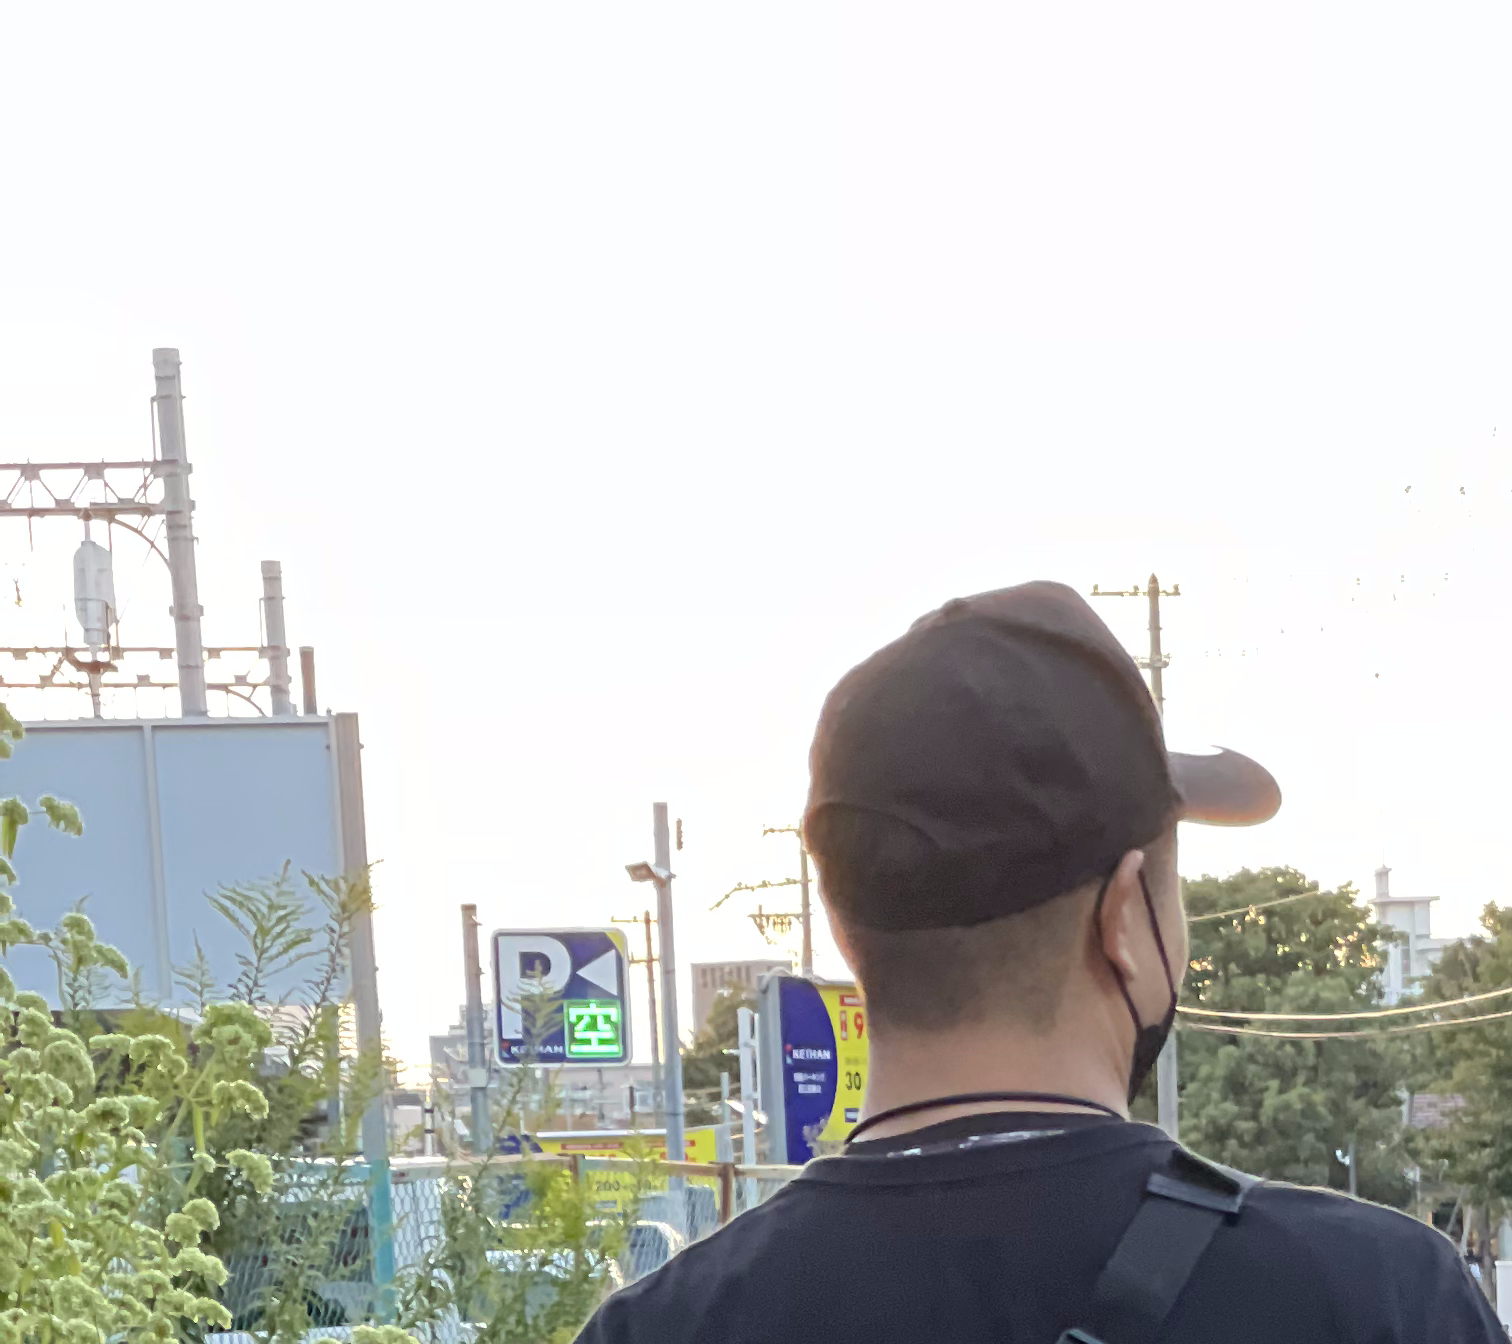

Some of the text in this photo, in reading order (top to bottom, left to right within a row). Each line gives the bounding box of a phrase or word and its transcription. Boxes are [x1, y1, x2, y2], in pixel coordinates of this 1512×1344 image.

[498, 936, 572, 1040] P
[568, 1002, 620, 1054] 空
[510, 1044, 564, 1054] KEHAN
[792, 1048, 831, 1060] KEIHAN
